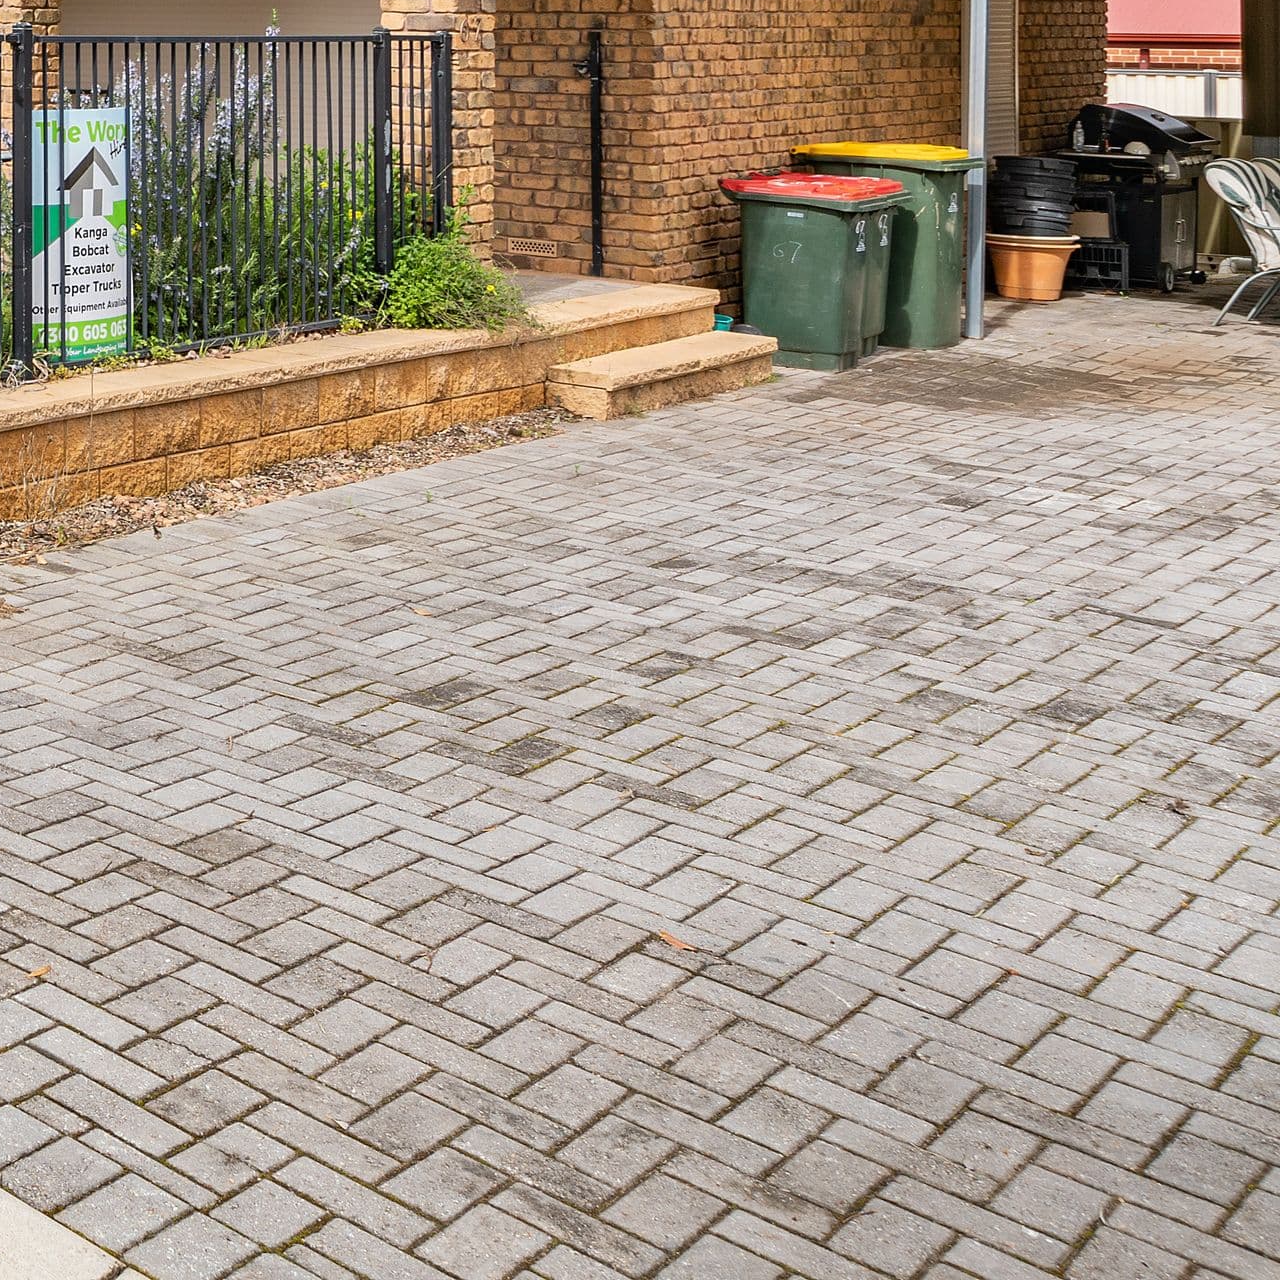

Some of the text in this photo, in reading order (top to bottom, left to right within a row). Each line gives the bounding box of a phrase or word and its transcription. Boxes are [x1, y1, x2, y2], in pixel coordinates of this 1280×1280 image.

[35, 120, 81, 144] The
[74, 227, 108, 240] Kanga
[72, 244, 109, 257] Bobcat
[773, 241, 803, 264] 67
[64, 262, 115, 276] Excavator
[51, 278, 122, 296] Tpper Trucks
[32, 305, 59, 315] Oter
[83, 324, 108, 341] 605
